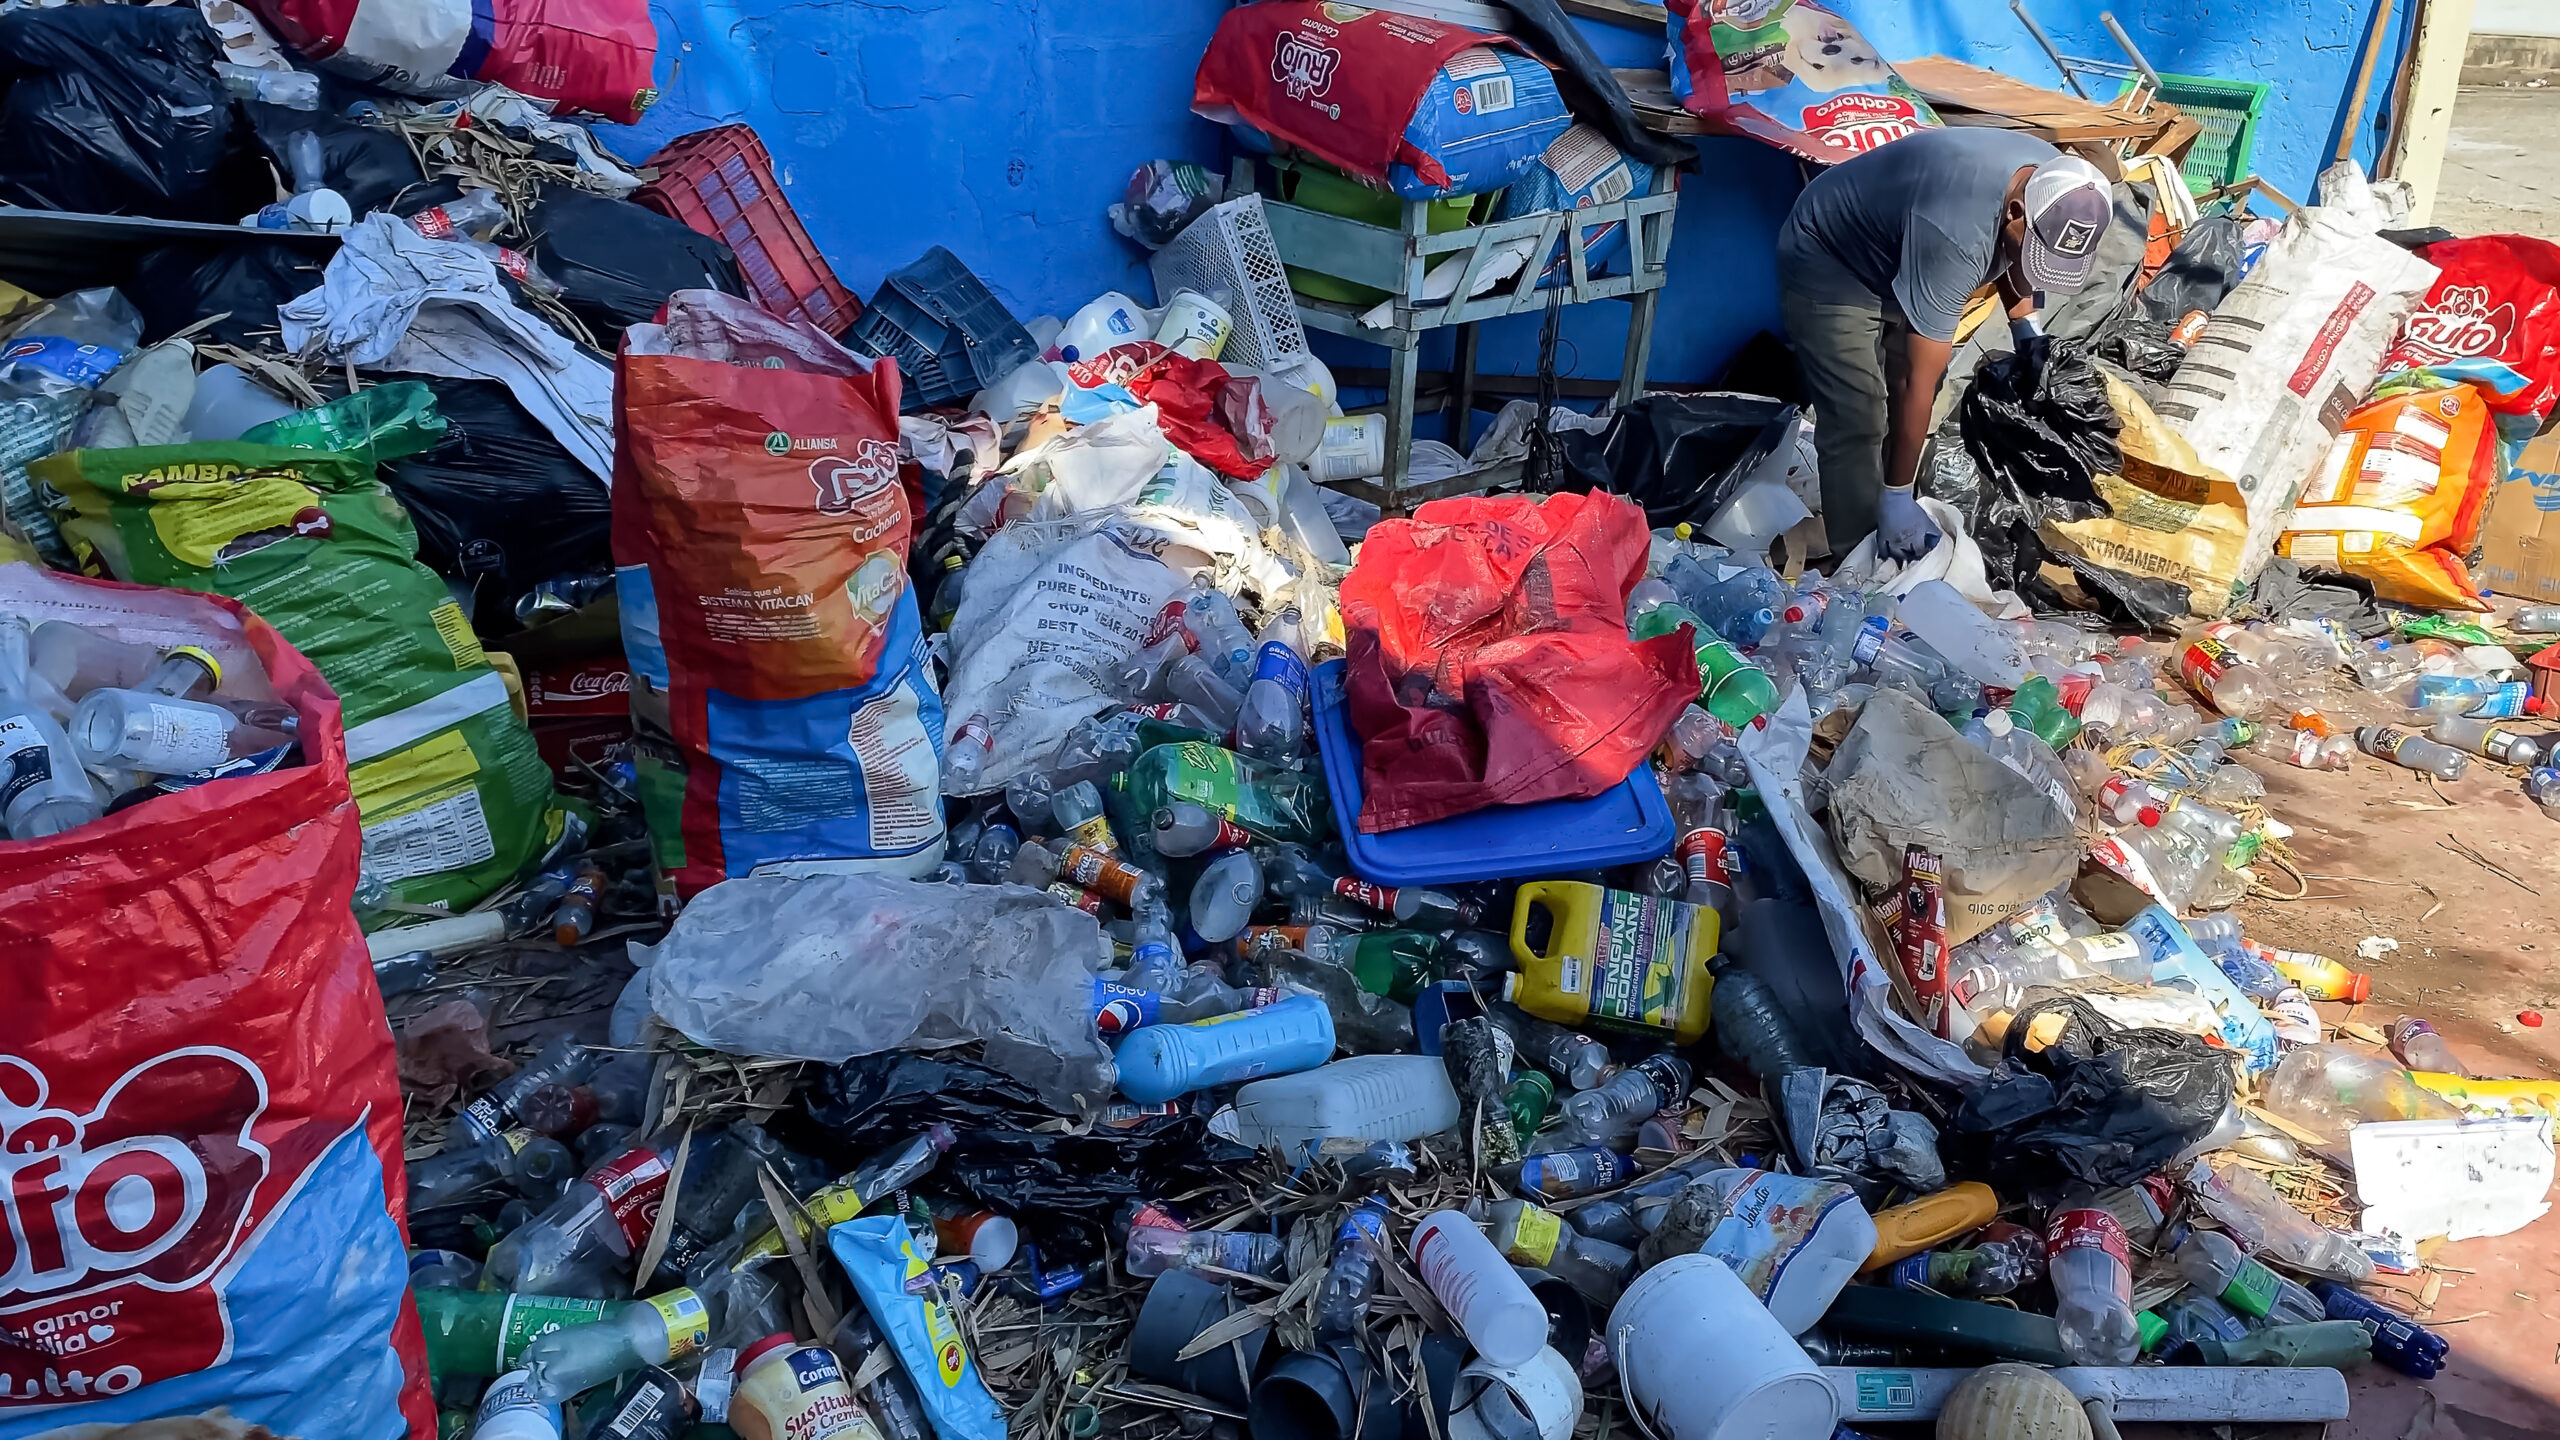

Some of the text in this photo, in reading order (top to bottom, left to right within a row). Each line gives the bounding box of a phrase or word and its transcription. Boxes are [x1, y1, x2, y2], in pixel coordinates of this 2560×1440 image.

[1301, 17, 1341, 38] Cachorro
[1280, 45, 1327, 83] Rufo
[1816, 94, 1902, 117] Cachorro
[793, 438, 838, 451] ALIANSA
[753, 588, 773, 599] que
[774, 586, 782, 595] el
[1036, 580, 1077, 596] PURE
[1057, 562, 1151, 606] INGREDIENTS:
[698, 593, 815, 610] SISTEMA VITACAN
[1036, 618, 1079, 634] BEST
[1047, 601, 1090, 618] CROP
[1093, 608, 1125, 635] YEAR
[1026, 640, 1061, 654] NET
[570, 671, 630, 693] Coca-Cola
[1968, 902, 1994, 915] 50lb
[1605, 902, 1627, 1000] ENGINE
[1615, 893, 1640, 1018] COOLANT
[1628, 956, 1642, 1018] REFRIGERANTE
[1636, 933, 1644, 955] PARA
[467, 1102, 503, 1137] POWER
[1593, 1153, 1604, 1172] Dog
[32, 1300, 124, 1337] amor
[0, 1364, 142, 1402] ulto
[799, 1363, 840, 1385] Corina
[801, 1409, 863, 1440] de Crema
